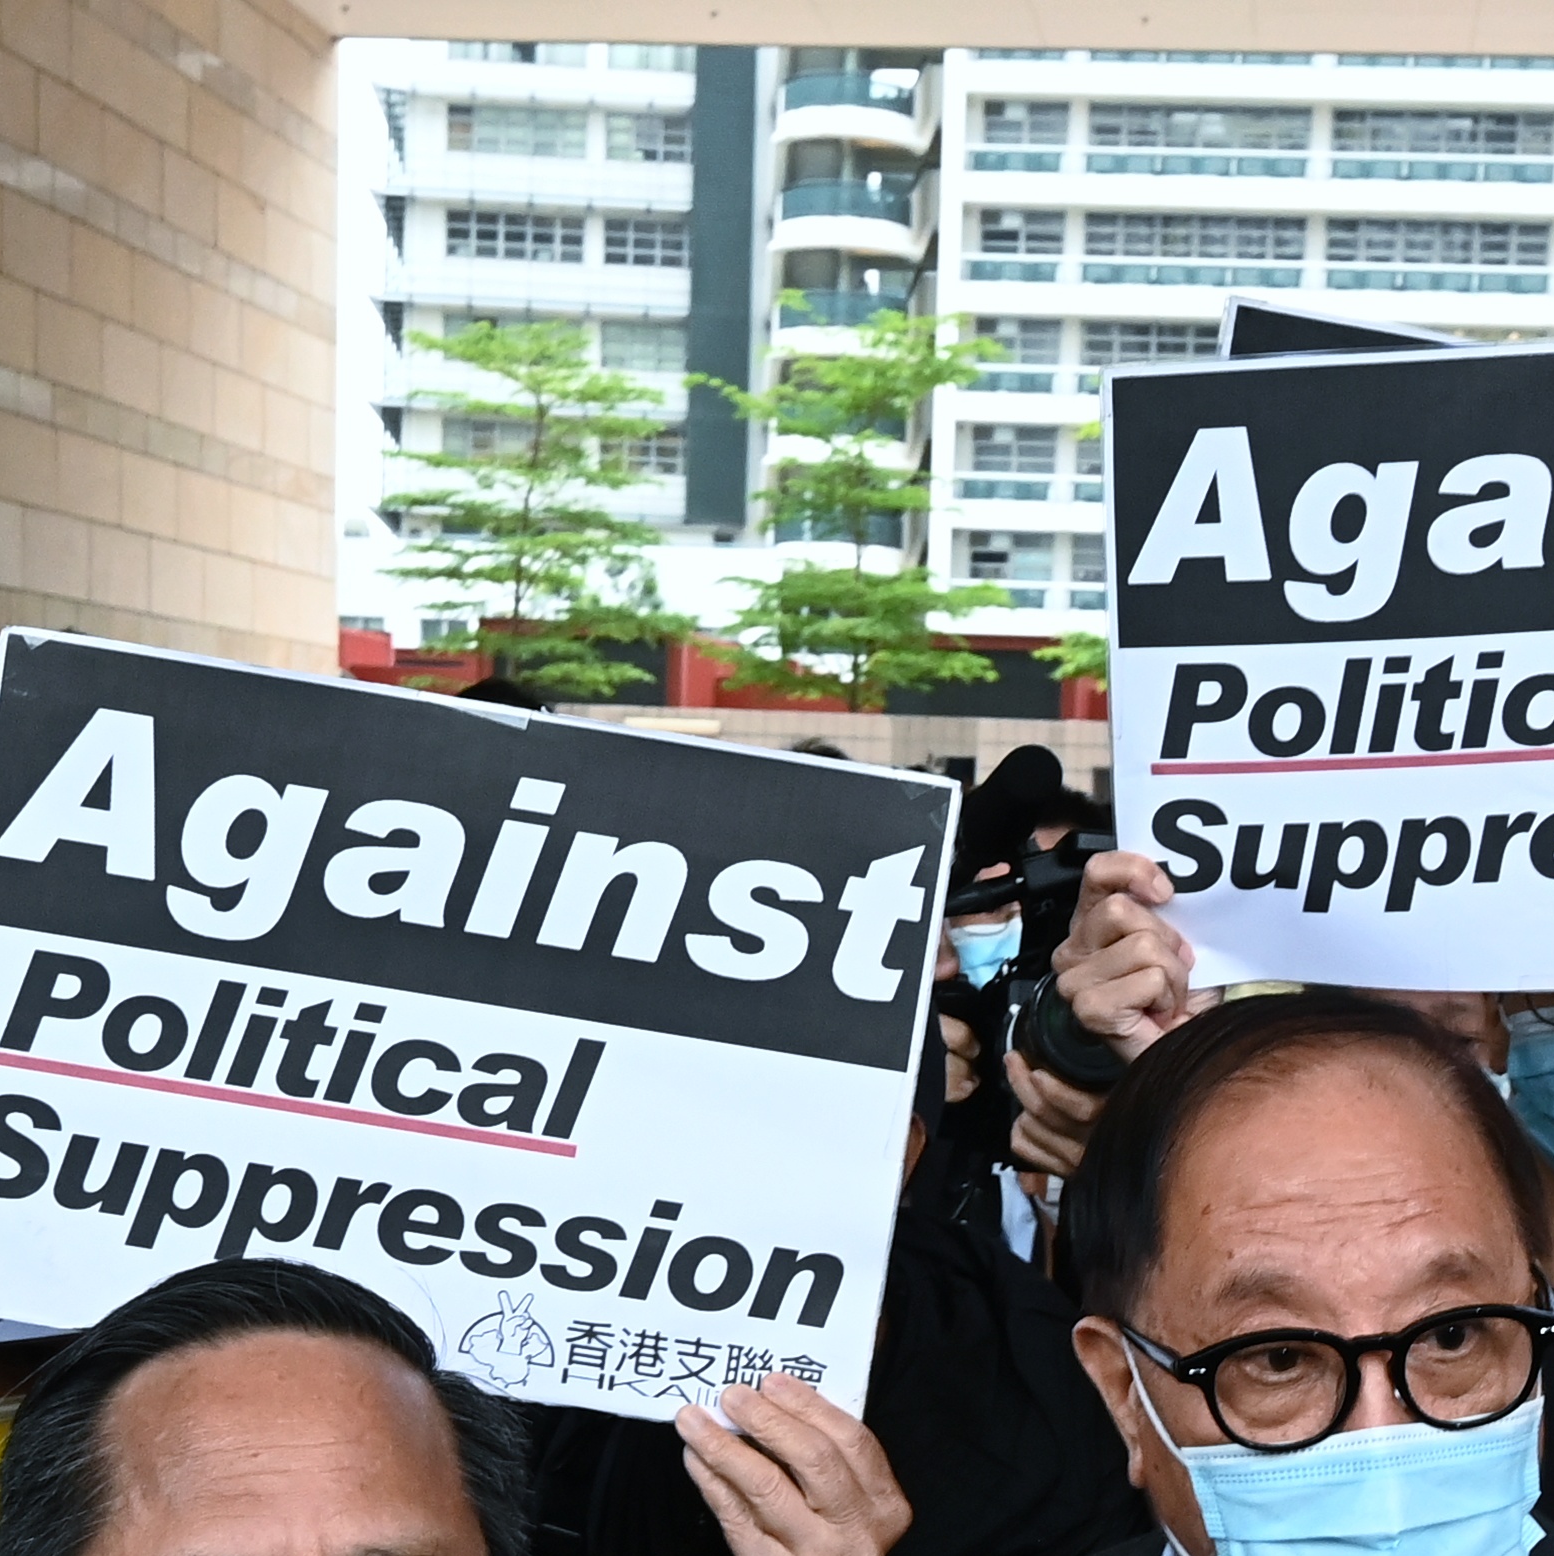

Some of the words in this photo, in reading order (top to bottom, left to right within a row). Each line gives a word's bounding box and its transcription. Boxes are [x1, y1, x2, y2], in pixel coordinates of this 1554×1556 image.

[565, 1319, 828, 1393] 香港支聯會
